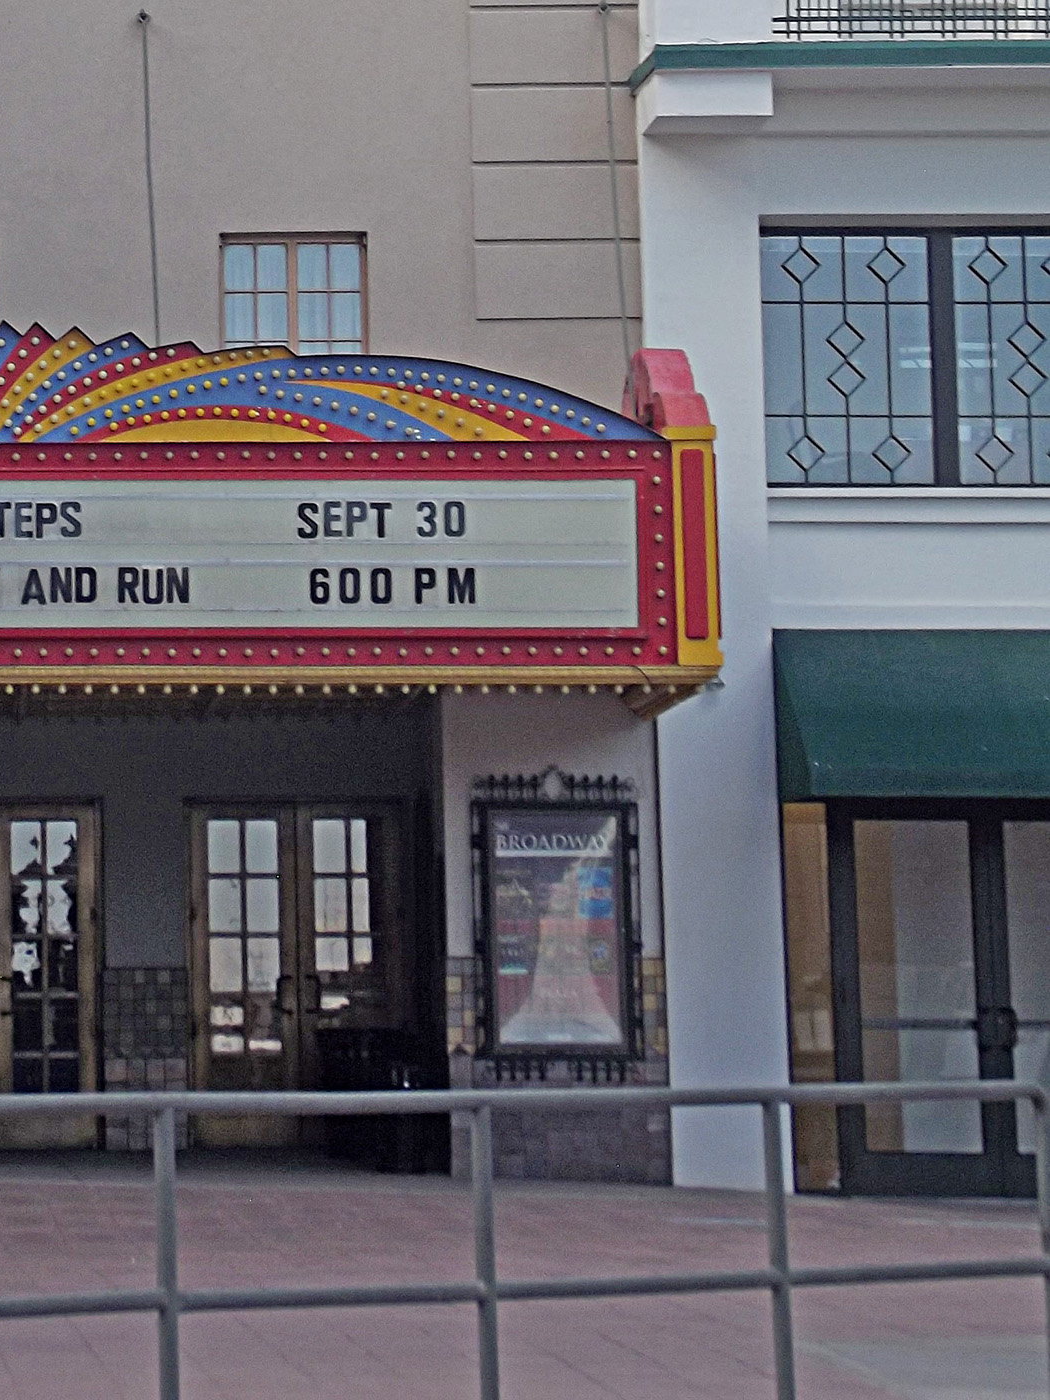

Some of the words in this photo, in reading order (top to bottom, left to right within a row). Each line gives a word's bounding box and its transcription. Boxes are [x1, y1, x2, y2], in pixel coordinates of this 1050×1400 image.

[296, 500, 393, 540] SEPT
[416, 500, 466, 538] 30
[20, 566, 98, 606] AND
[117, 566, 190, 605] RUN
[309, 567, 393, 605] 600
[495, 833, 608, 851] BROADWAY
